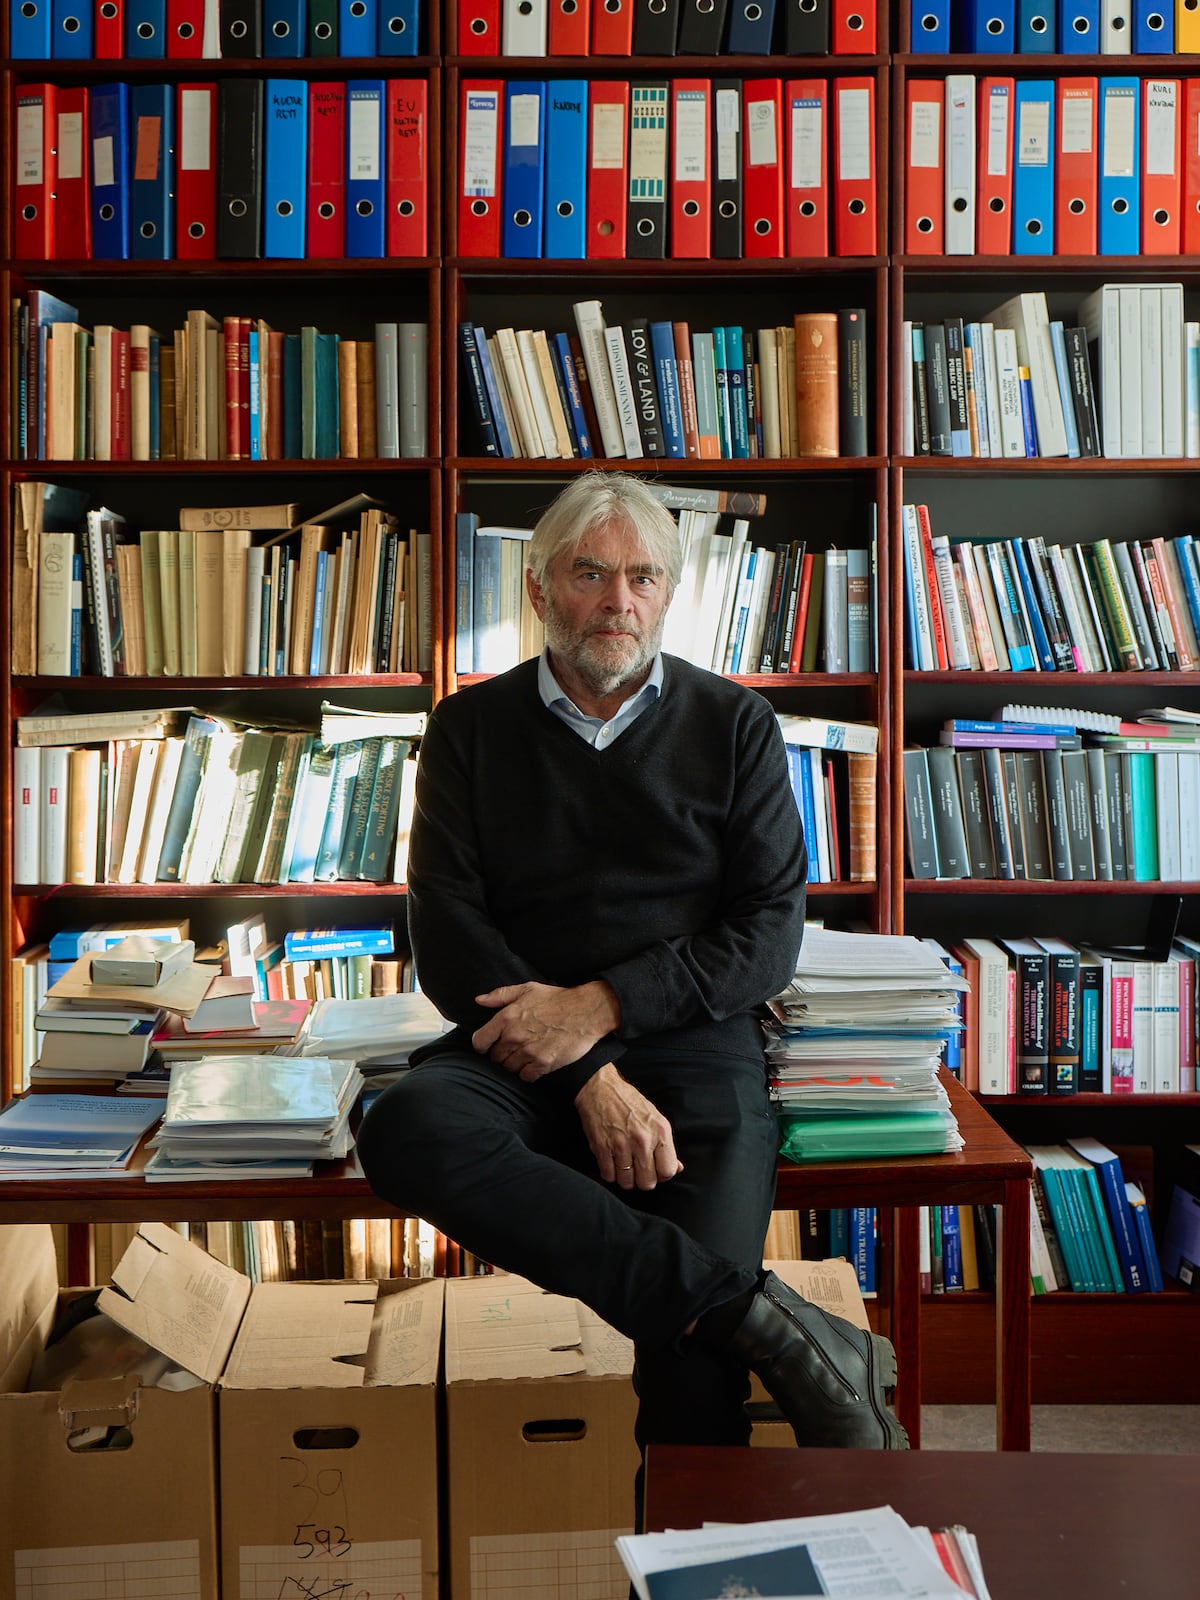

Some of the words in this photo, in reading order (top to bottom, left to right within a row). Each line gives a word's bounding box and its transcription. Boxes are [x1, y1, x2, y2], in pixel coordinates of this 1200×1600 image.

[630, 327, 647, 360] LOV
[635, 360, 649, 378] &
[947, 358, 955, 384] PUBLIC
[953, 357, 964, 396] EUROPEAN
[638, 377, 656, 422] LAND
[949, 385, 957, 401] LAW
[957, 397, 966, 423] UNION
[663, 490, 707, 506] Paragrafen
[354, 798, 368, 837] STORTING
[375, 794, 390, 837] STORTING
[325, 851, 332, 862] 2
[348, 851, 355, 862] 3
[367, 852, 376, 861] 4
[1067, 992, 1075, 1011] Oxford
[1030, 1030, 1036, 1040] OF
[1067, 1012, 1075, 1040] Handbook
[858, 1264, 866, 1282] LAW
[293, 1524, 353, 1559] 593
